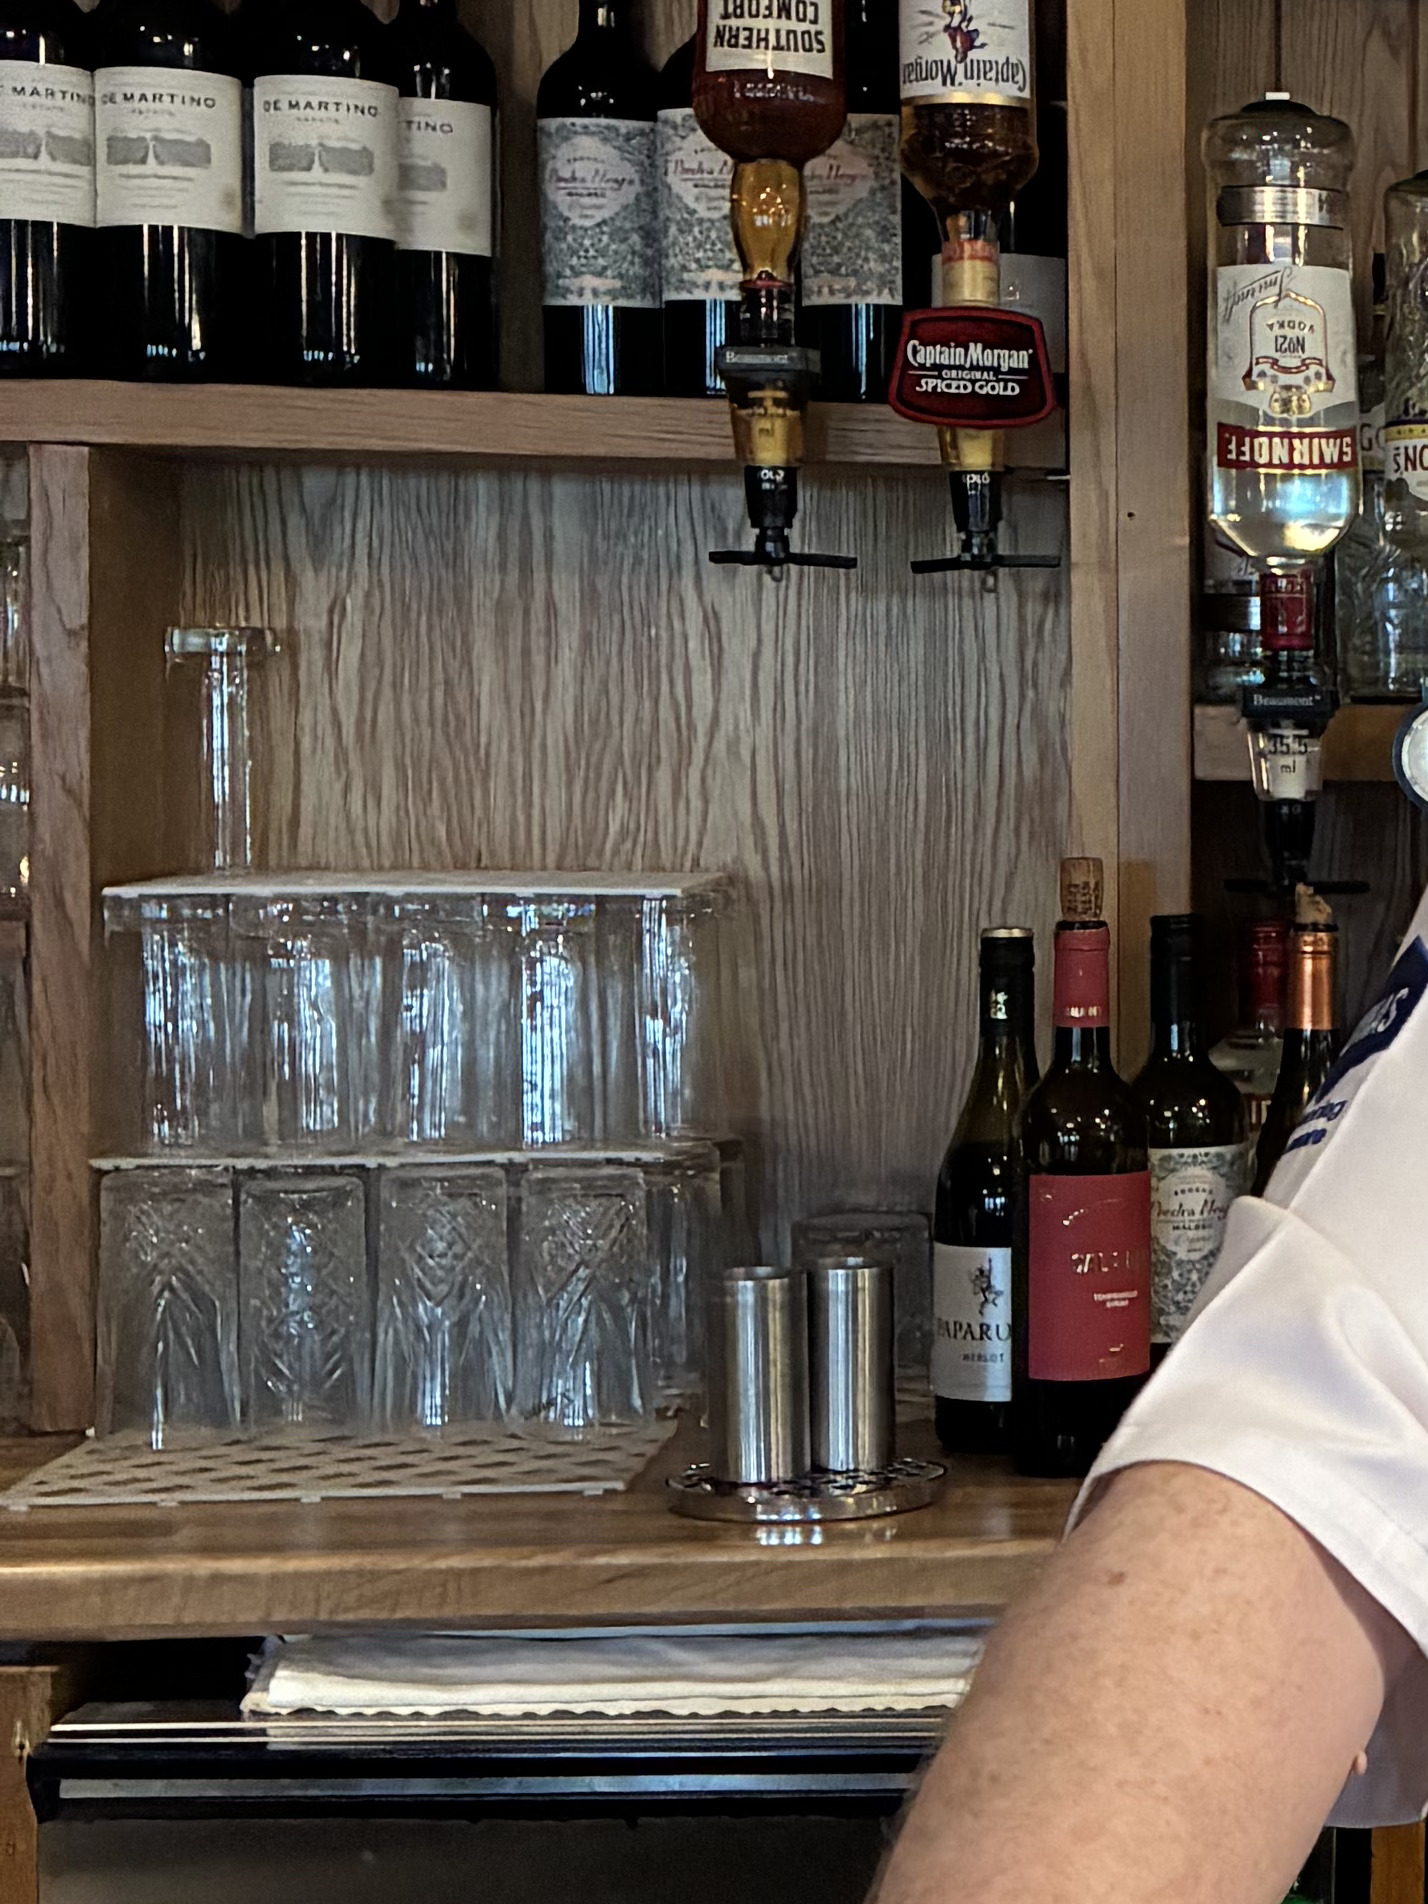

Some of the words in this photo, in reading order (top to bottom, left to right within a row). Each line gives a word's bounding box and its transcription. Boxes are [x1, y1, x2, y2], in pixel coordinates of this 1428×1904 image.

[713, 24, 826, 53] SOUTHERN
[964, 55, 1027, 93] Captain
[123, 92, 218, 110] MARTINO
[263, 99, 283, 114] DE
[288, 99, 380, 118] MARTINO
[402, 119, 454, 135] TINO
[1266, 319, 1316, 334] VODKA
[906, 339, 965, 368] Captain
[965, 341, 1030, 372] Morgan
[941, 369, 997, 381] ORIGINAL
[915, 377, 973, 394] SPICED
[974, 380, 1021, 396] GOLD
[1226, 436, 1352, 465] SMIRNOFF
